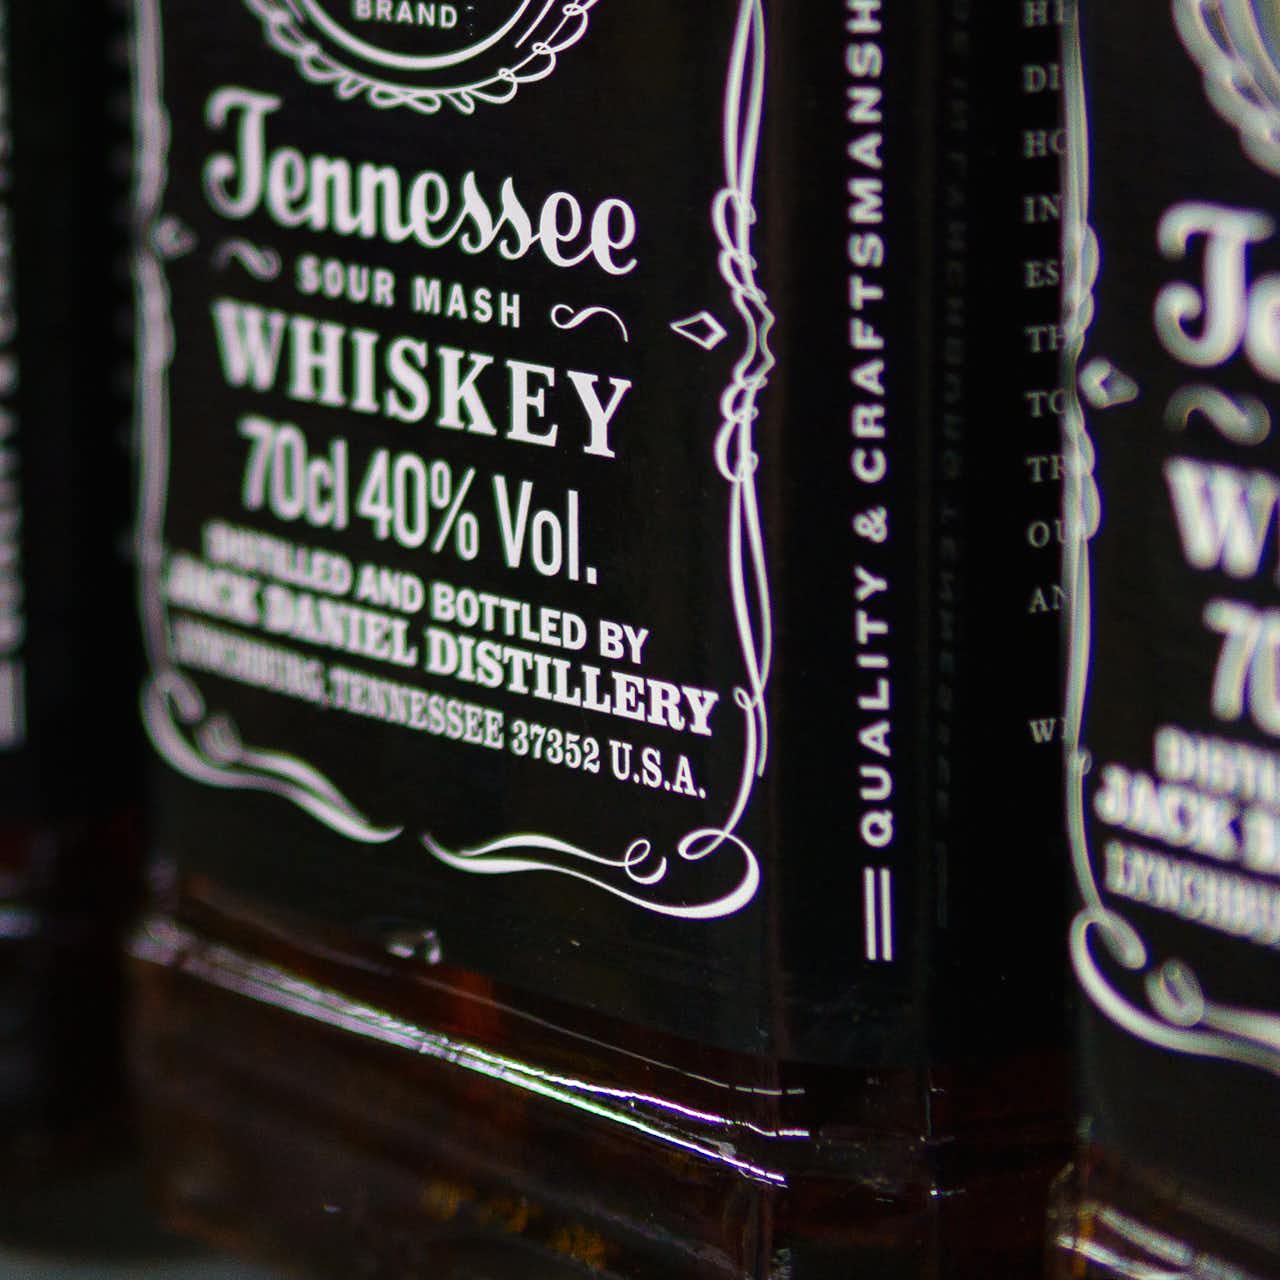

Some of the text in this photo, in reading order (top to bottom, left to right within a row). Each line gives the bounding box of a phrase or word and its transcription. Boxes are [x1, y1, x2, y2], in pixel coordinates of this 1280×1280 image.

[204, 86, 638, 275] Tennessee
[296, 253, 521, 327] SOUR MASH
[211, 298, 631, 459] WHISKEY
[239, 417, 598, 585] 70cl 40% Vol.
[854, 505, 888, 543] &
[206, 520, 648, 664] DISTILLED AND BOTTLED BY
[263, 583, 418, 667] DANIEL
[426, 626, 718, 736] DISTILLERY
[330, 667, 504, 750] TENNESSEE
[511, 720, 600, 772] 37352
[610, 738, 706, 799] U.S.A.
[855, 566, 892, 848] QUALITY
